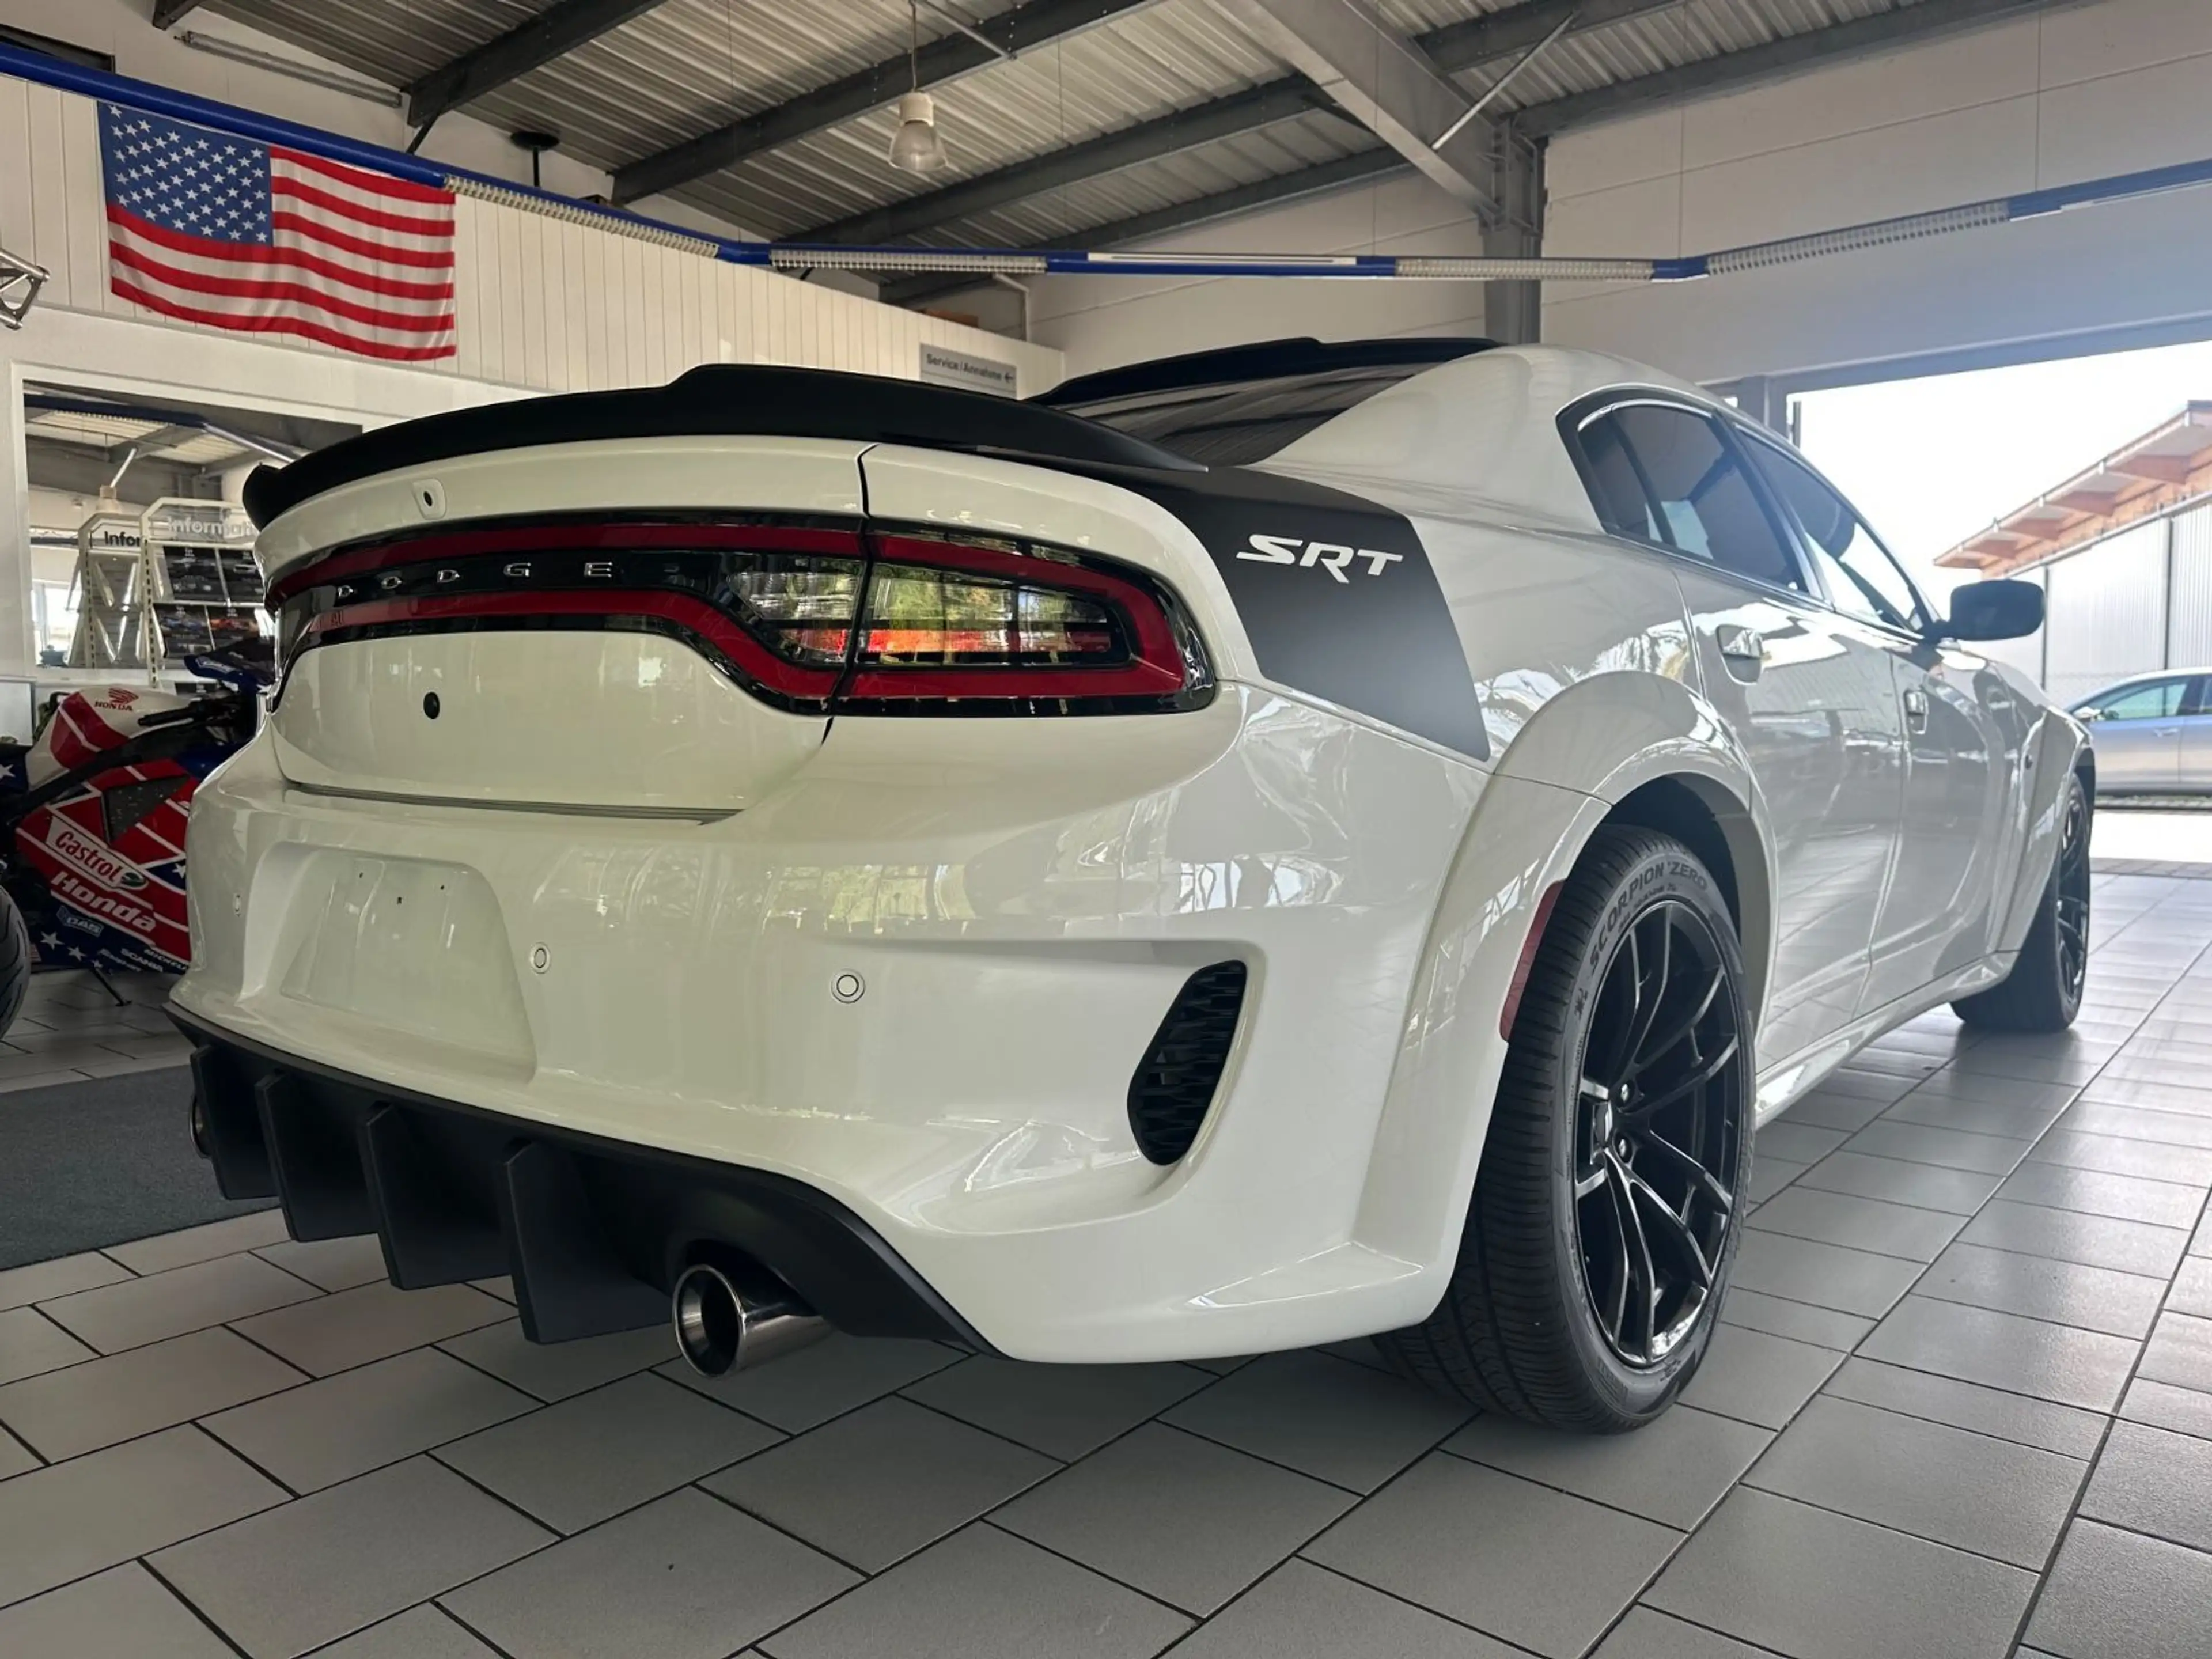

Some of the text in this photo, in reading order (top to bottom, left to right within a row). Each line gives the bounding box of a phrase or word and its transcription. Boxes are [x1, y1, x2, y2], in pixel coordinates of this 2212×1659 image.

[337, 561, 613, 598] DODGE
[1236, 533, 1403, 584] SRT
[94, 700, 132, 711] HONDA
[56, 831, 124, 882] Castrol
[51, 871, 156, 932] Honda
[1590, 862, 1664, 974] SCORPION
[1668, 861, 1707, 891] ZERO
